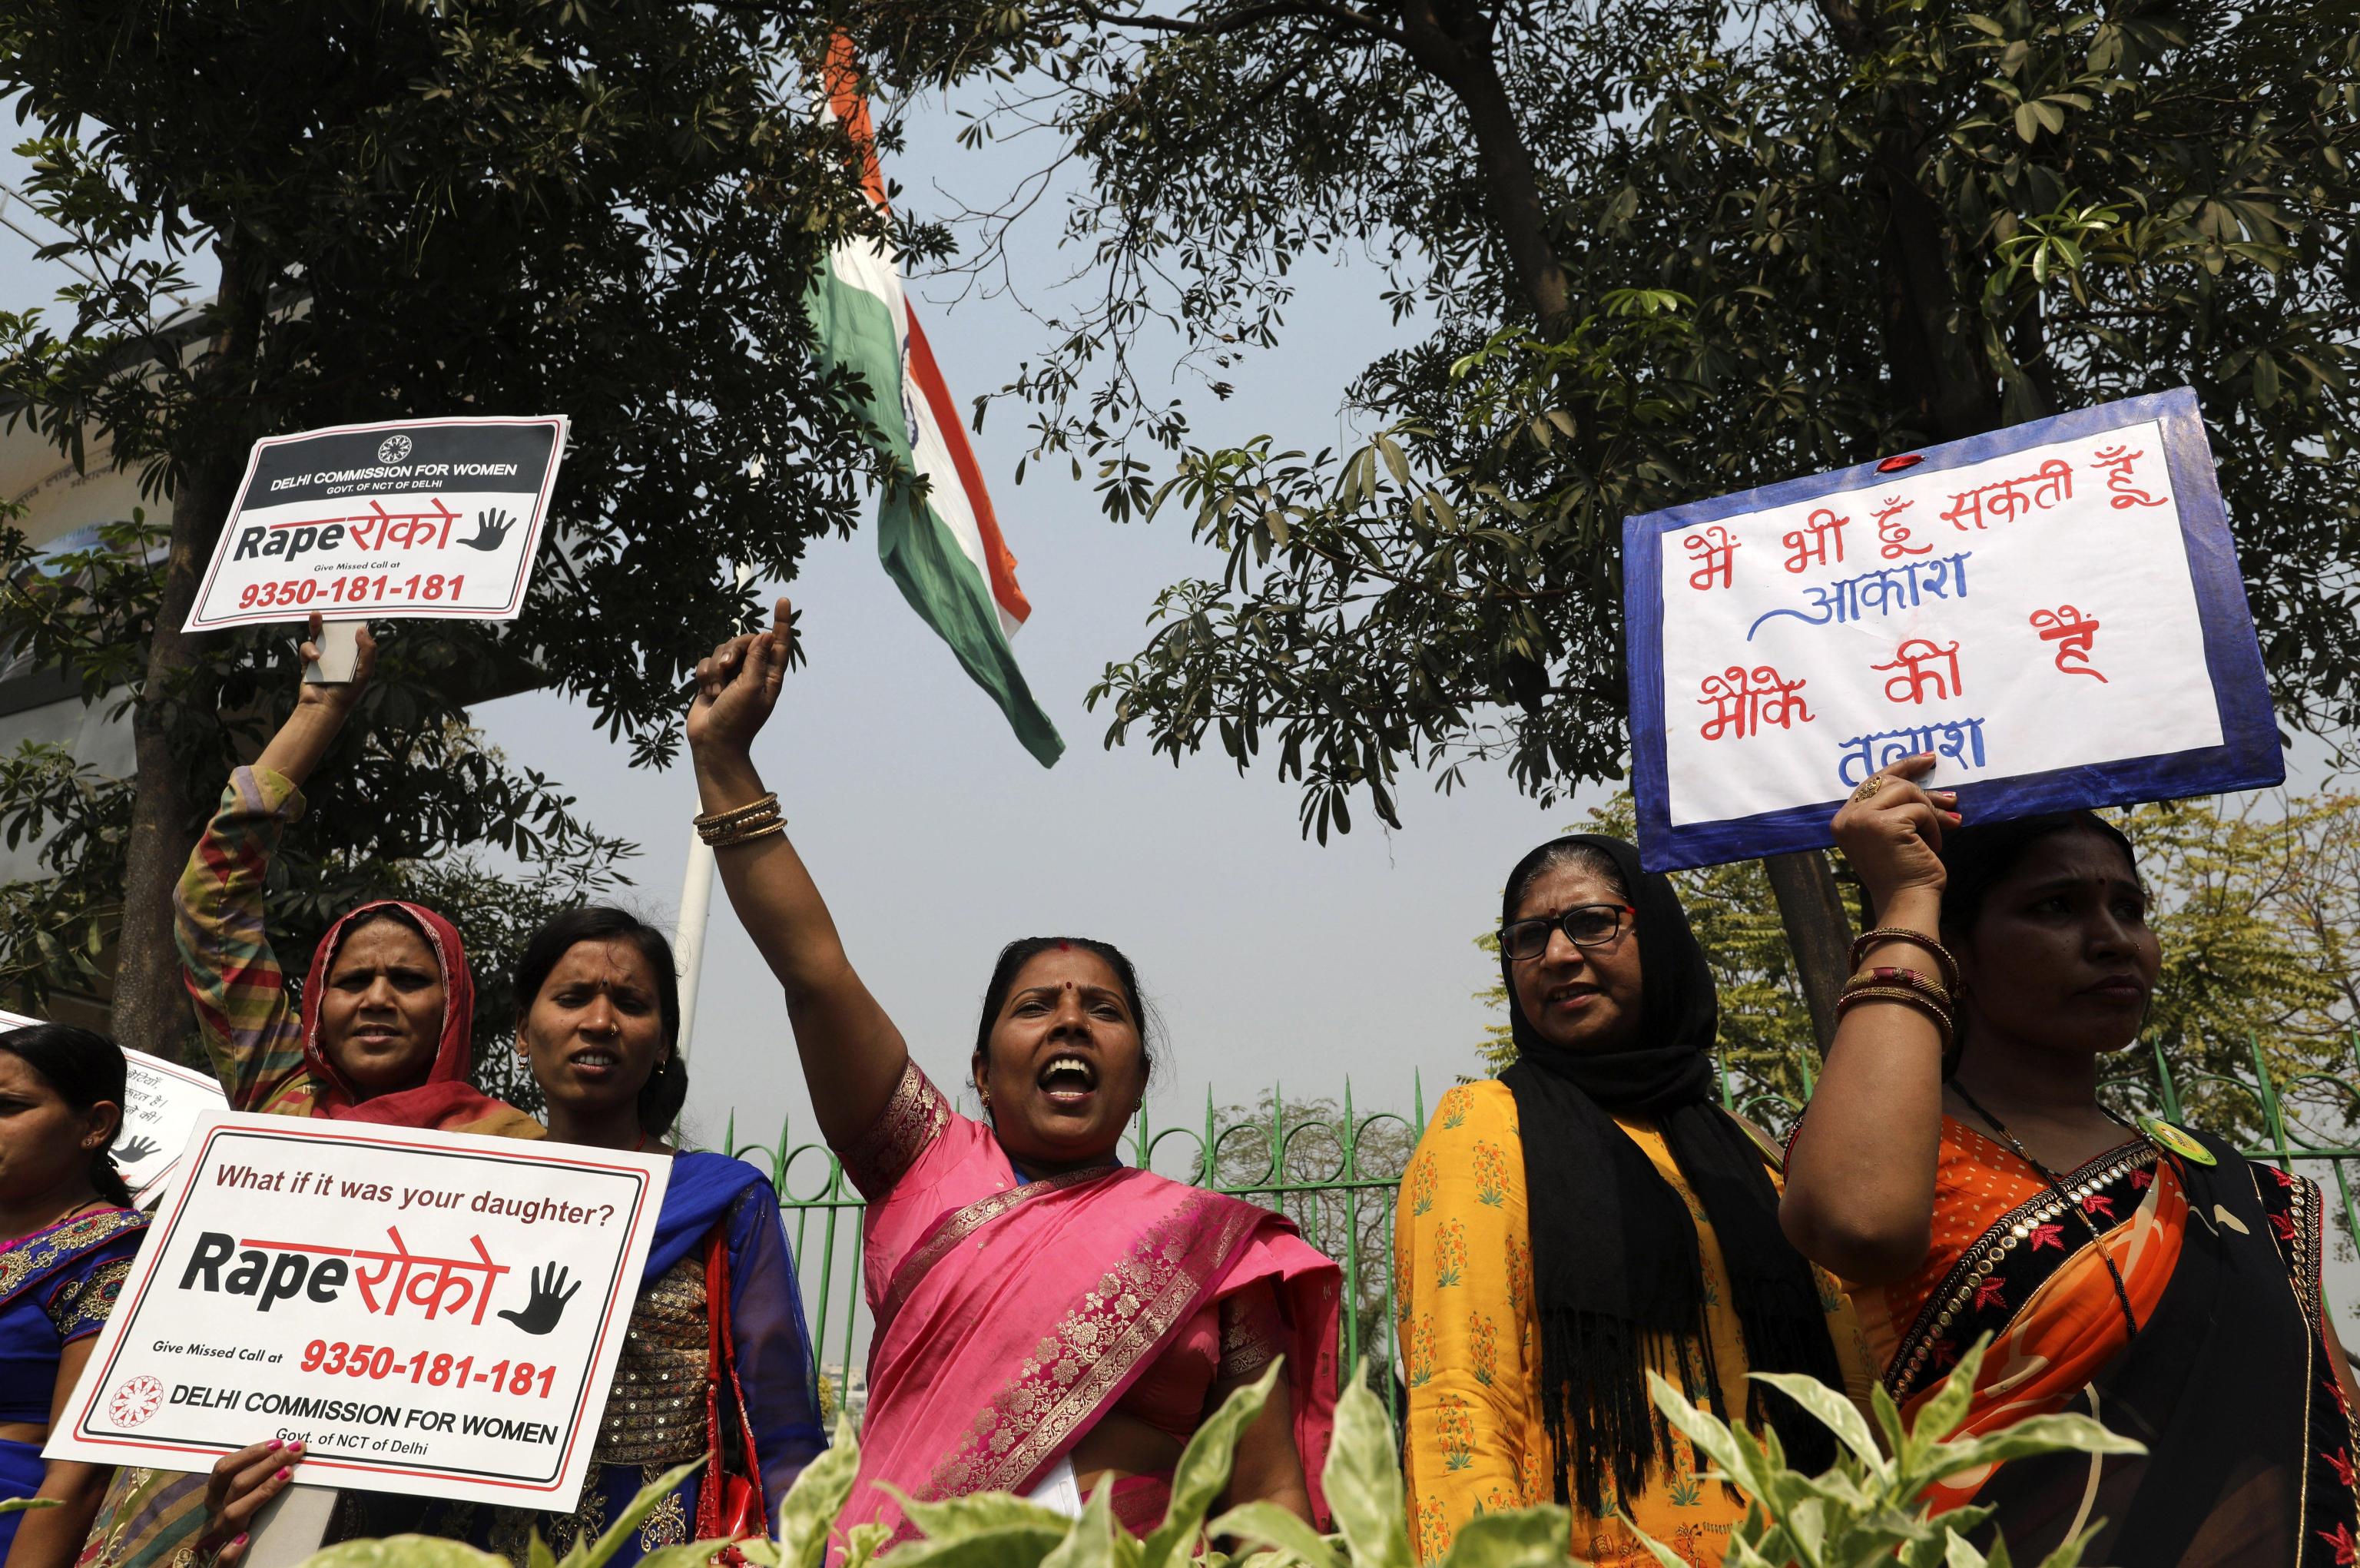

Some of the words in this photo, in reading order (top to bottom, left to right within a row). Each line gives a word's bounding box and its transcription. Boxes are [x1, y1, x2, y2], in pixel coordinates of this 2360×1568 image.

[270, 473, 312, 492] DELHI
[313, 466, 413, 484] COMMISSION
[415, 464, 450, 476] FOR
[452, 463, 518, 476] WOMEN
[326, 486, 354, 496] GOVT.
[356, 483, 370, 492] OF
[373, 482, 394, 490] NCT
[395, 481, 409, 489] OF
[411, 479, 443, 489] DELHI
[233, 523, 346, 562] Rape
[346, 497, 463, 552] रोको
[1683, 525, 1742, 591] मैं
[1782, 508, 1850, 574] भी
[1939, 459, 2073, 531] सकती
[2089, 445, 2169, 510] हूँ
[238, 574, 465, 609] 9350-181-181
[313, 564, 335, 572] Give
[336, 562, 368, 571] Missed
[370, 561, 389, 569] Call
[1746, 550, 1973, 641] आकाश
[1696, 665, 1816, 741] मौके
[1870, 638, 1963, 704] की
[216, 1163, 286, 1192] What
[289, 1172, 313, 1195] if
[313, 1173, 334, 1196] it
[340, 1180, 393, 1203] was
[397, 1186, 465, 1212] your
[470, 1190, 615, 1228] daughter?
[178, 1231, 350, 1313] Rape
[352, 1225, 512, 1327] रोको
[152, 1340, 184, 1355] Give
[186, 1343, 236, 1361] Missed
[238, 1348, 267, 1362] Call
[267, 1352, 283, 1364] at
[300, 1338, 558, 1400] 9350-181-181
[169, 1384, 242, 1411] DELHI
[244, 1391, 403, 1428] COMMISSION
[404, 1409, 456, 1433] FOR
[462, 1414, 560, 1446] WOMEN
[275, 1427, 313, 1444] Govt.
[318, 1433, 336, 1446] of
[336, 1434, 370, 1450] NCT
[372, 1439, 389, 1451] of
[389, 1439, 429, 1456] Delhi
